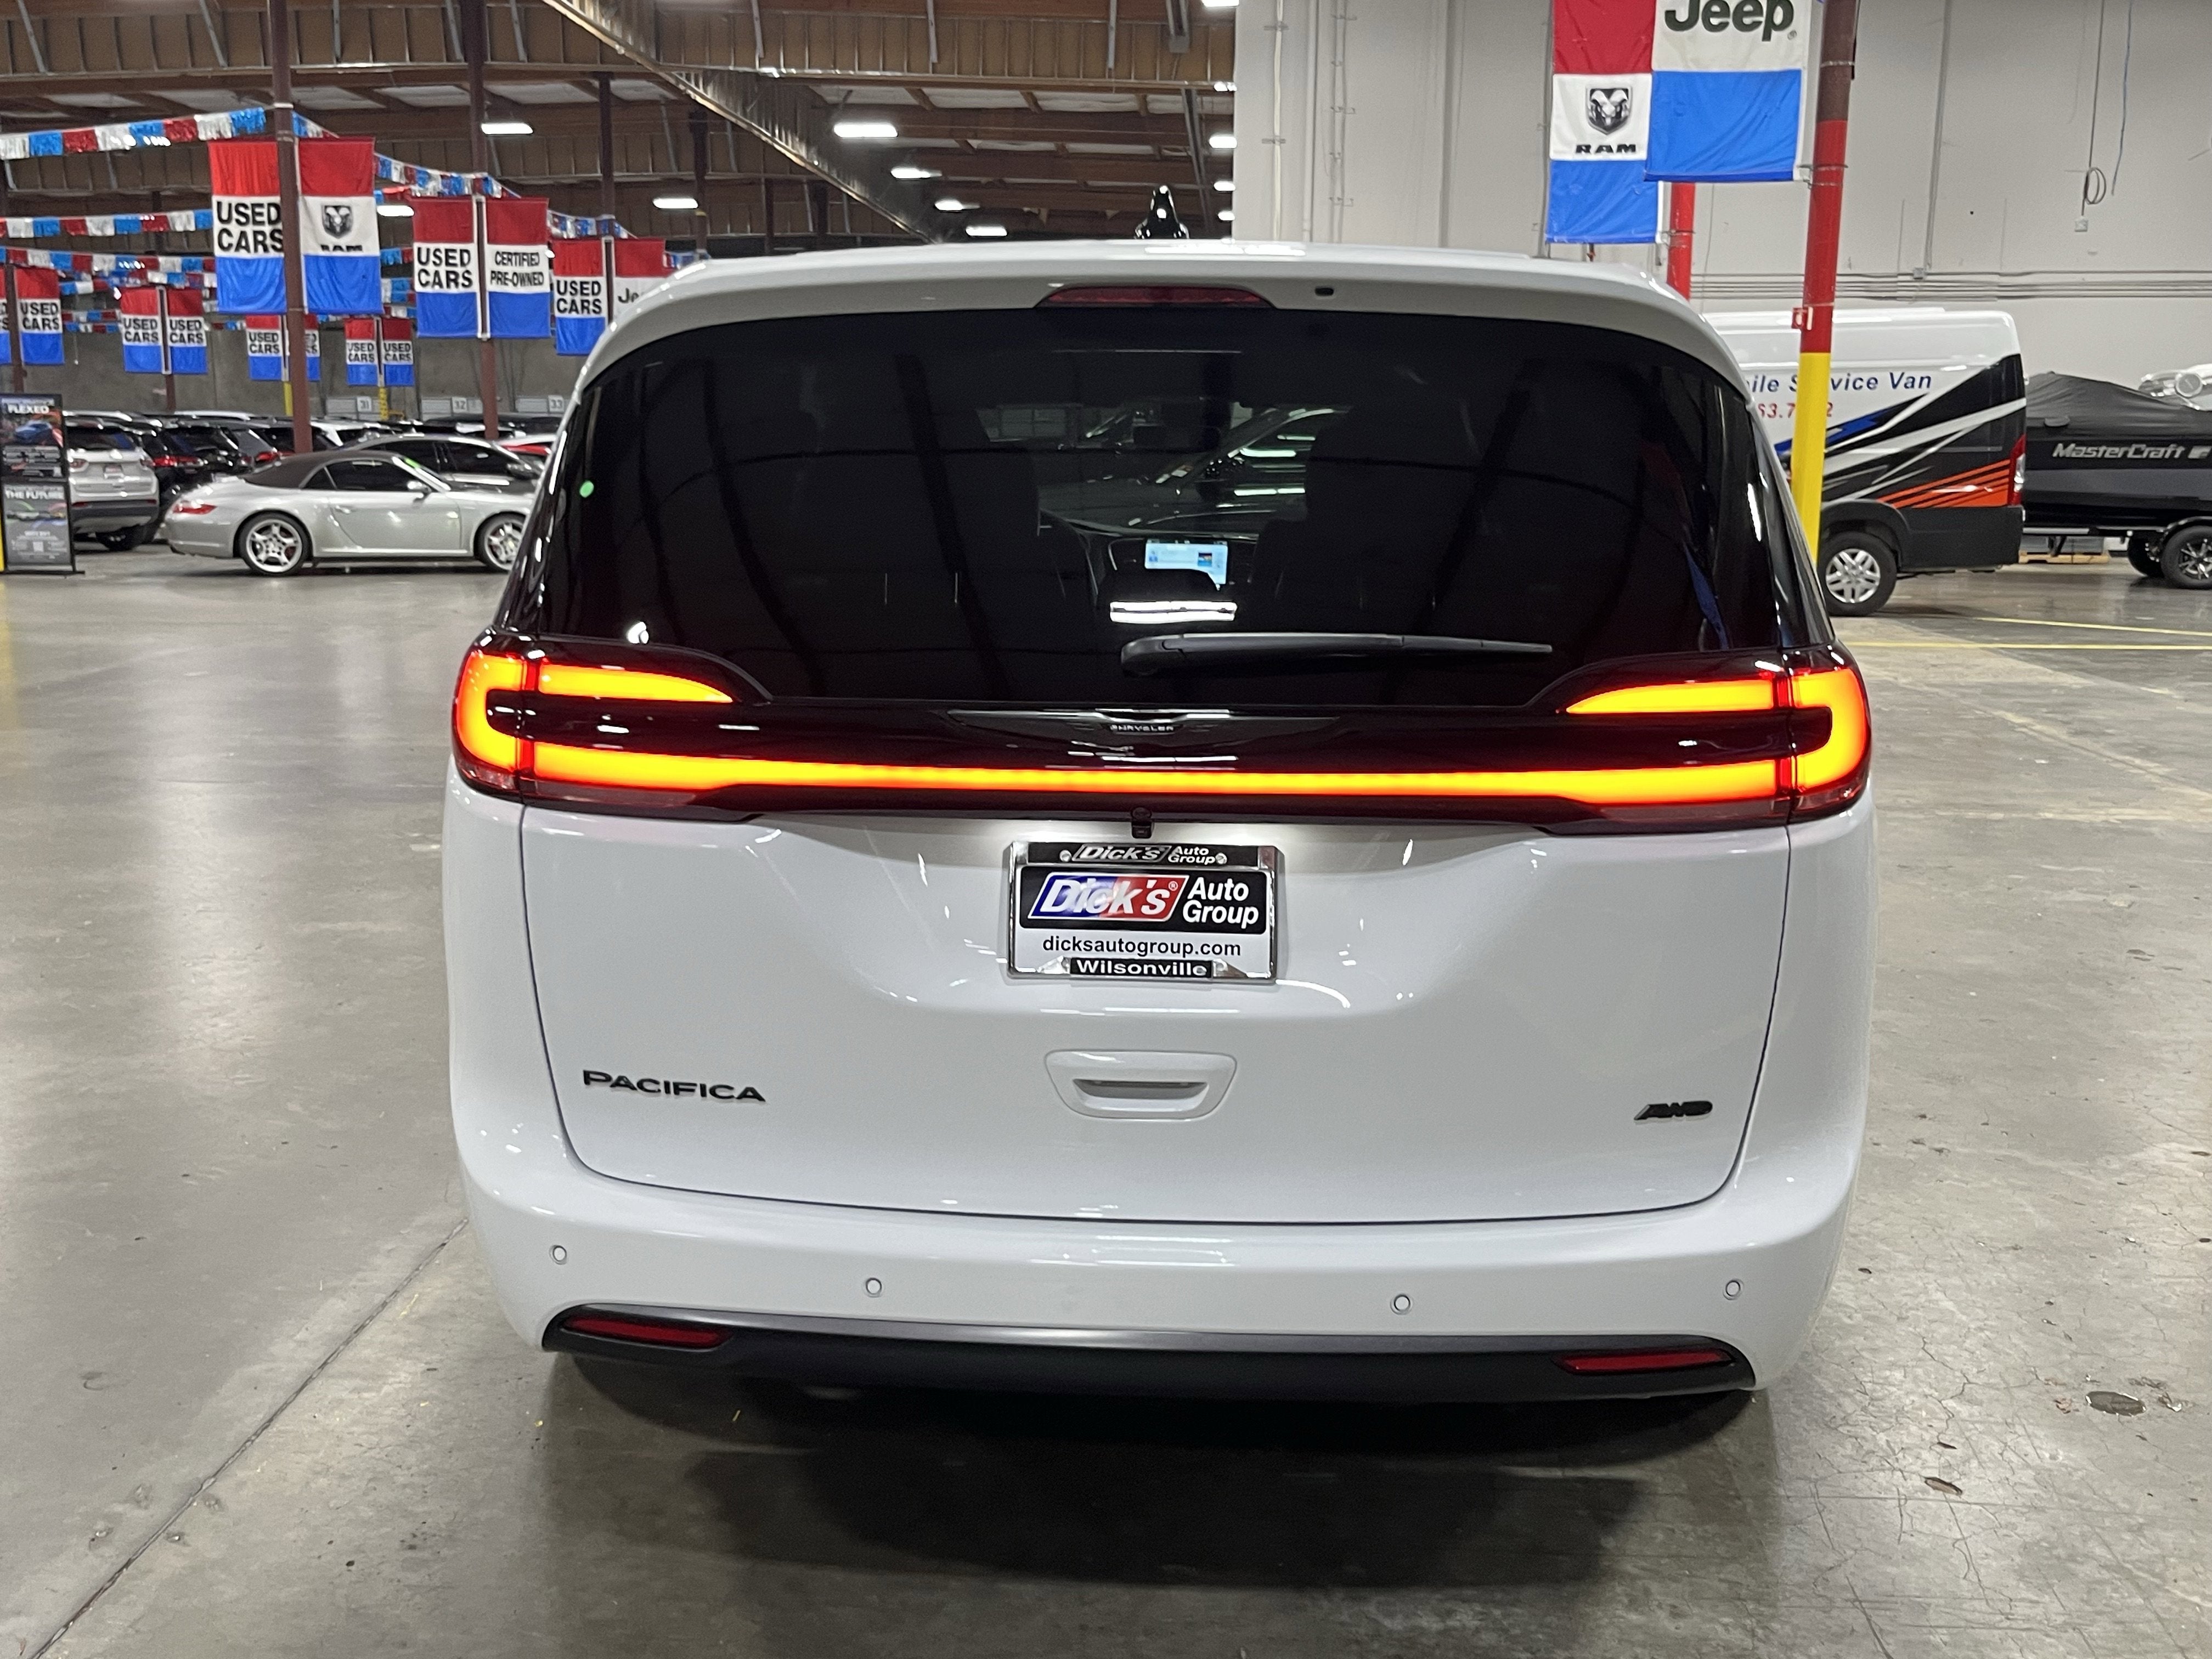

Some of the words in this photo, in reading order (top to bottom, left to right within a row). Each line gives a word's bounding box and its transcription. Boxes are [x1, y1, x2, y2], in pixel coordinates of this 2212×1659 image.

[1664, 0, 1794, 42] Jeep
[1576, 144, 1636, 154] RAM
[217, 201, 281, 227] USED
[218, 228, 284, 253] CARS
[417, 247, 471, 267] USED
[495, 251, 540, 267] CERTIFIED
[418, 268, 473, 289] CARS
[490, 270, 544, 287] PRE-OWNED
[556, 280, 601, 296] USED
[20, 302, 59, 315] USED
[556, 298, 602, 314] CARS
[22, 317, 60, 330] CARS
[123, 318, 158, 330] USED
[170, 319, 202, 331] USED
[125, 331, 159, 343] CARS
[170, 332, 203, 344] CARS
[249, 332, 279, 342] USED
[250, 344, 280, 354] CARS
[347, 342, 374, 352] USED
[383, 343, 411, 353] USED
[348, 353, 375, 362] CARS
[385, 354, 411, 362] CARS
[1889, 371, 1932, 390] Van
[551, 399, 563, 409] 33
[2052, 443, 2186, 459] MasterCraft
[1079, 845, 1161, 860] Dick's
[1171, 845, 1209, 855] Auto
[1168, 854, 1216, 865] Group
[1187, 877, 1250, 901] Auto
[1182, 900, 1260, 929] Group
[1042, 935, 1242, 958] dicksautogroup.com
[1076, 958, 1207, 977] Wilsonville
[583, 1070, 766, 1102] PACIFICA
